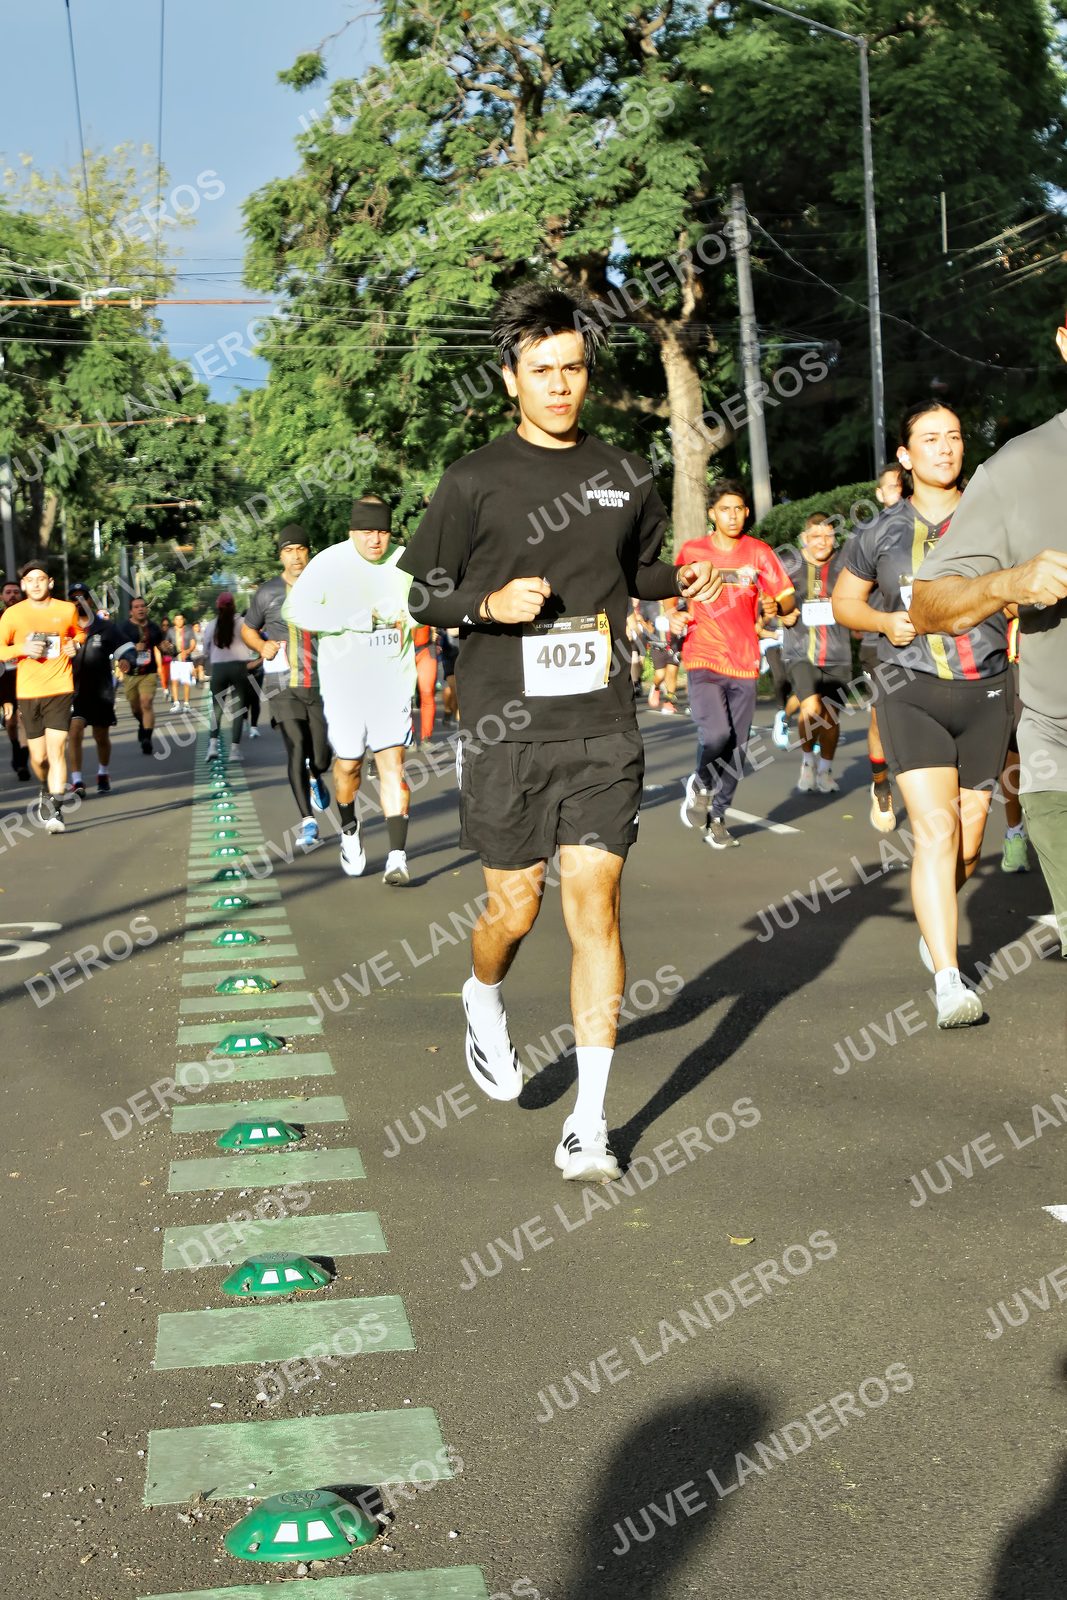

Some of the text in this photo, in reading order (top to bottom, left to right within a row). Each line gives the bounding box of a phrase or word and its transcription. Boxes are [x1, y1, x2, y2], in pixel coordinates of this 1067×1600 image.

[586, 489, 630, 500] RUNNING
[598, 497, 624, 507] CLUB
[536, 641, 596, 669] 4025
